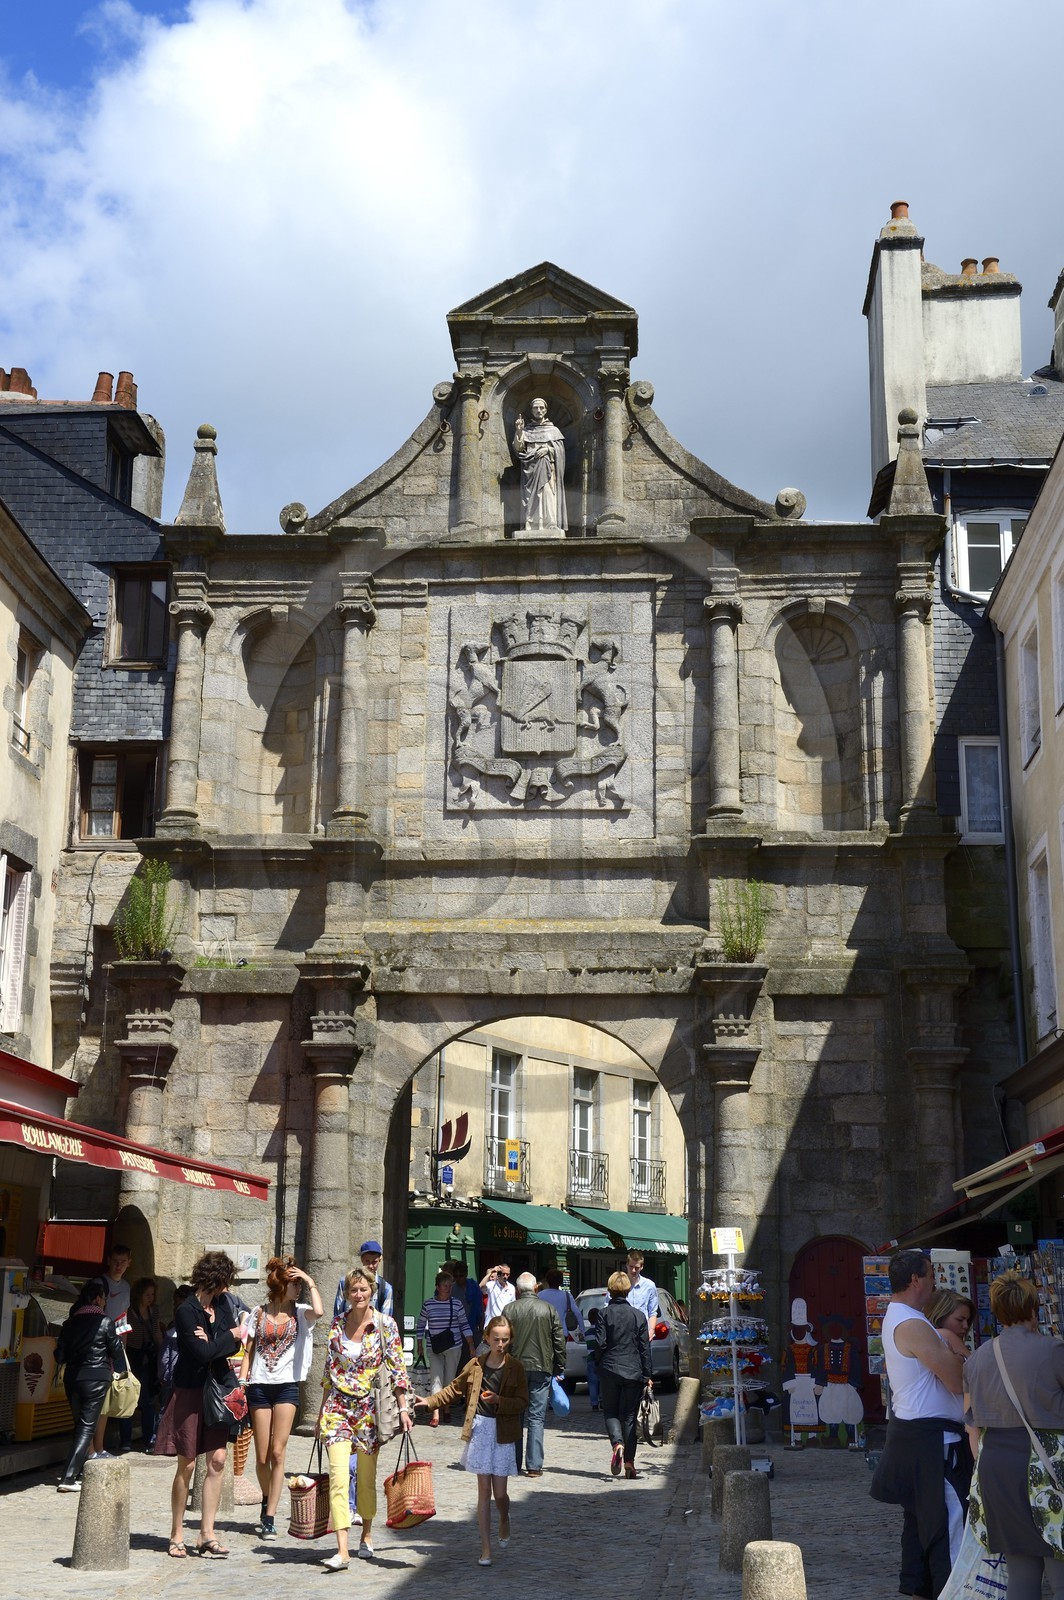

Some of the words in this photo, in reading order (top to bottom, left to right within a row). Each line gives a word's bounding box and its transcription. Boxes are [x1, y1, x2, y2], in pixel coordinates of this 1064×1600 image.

[21, 1123, 85, 1157] BOULANGERIE
[118, 1150, 159, 1173] PATISSERIE
[232, 1179, 251, 1194] GLACES
[493, 1222, 502, 1237] Le
[548, 1234, 560, 1243] LE
[560, 1235, 590, 1247] SINAGOT
[654, 1242, 670, 1251] BAR
